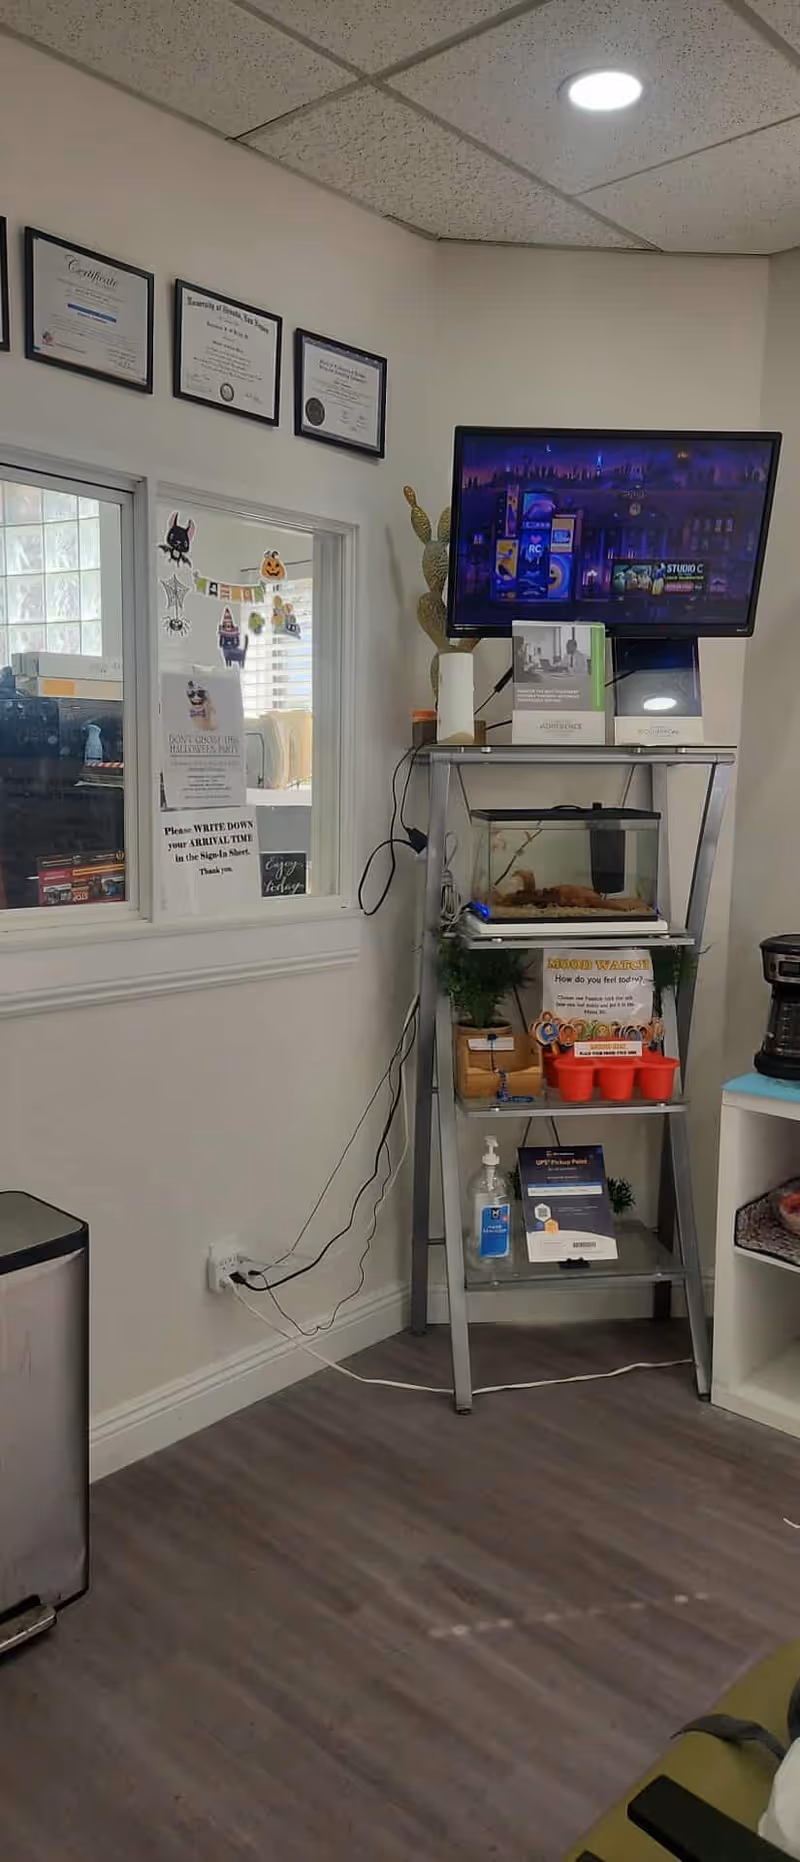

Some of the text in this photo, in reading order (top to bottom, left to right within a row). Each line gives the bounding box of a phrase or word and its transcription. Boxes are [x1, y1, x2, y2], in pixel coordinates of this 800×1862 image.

[65, 254, 118, 289] Certificate
[666, 563, 704, 574] STUDIO C
[164, 820, 254, 835] Please WRITE DOWN
[168, 834, 252, 852] your ARRIVAL TIME
[175, 853, 184, 862] in
[185, 852, 199, 861] the
[200, 849, 228, 860] Sign-In
[199, 866, 220, 876] Thank
[265, 856, 304, 879] Enjoy
[264, 877, 304, 894] today
[547, 958, 649, 971] MOOD WATCH
[554, 974, 572, 983] How
[574, 974, 585, 983] do
[587, 976, 602, 985] you
[604, 975, 617, 983] feel
